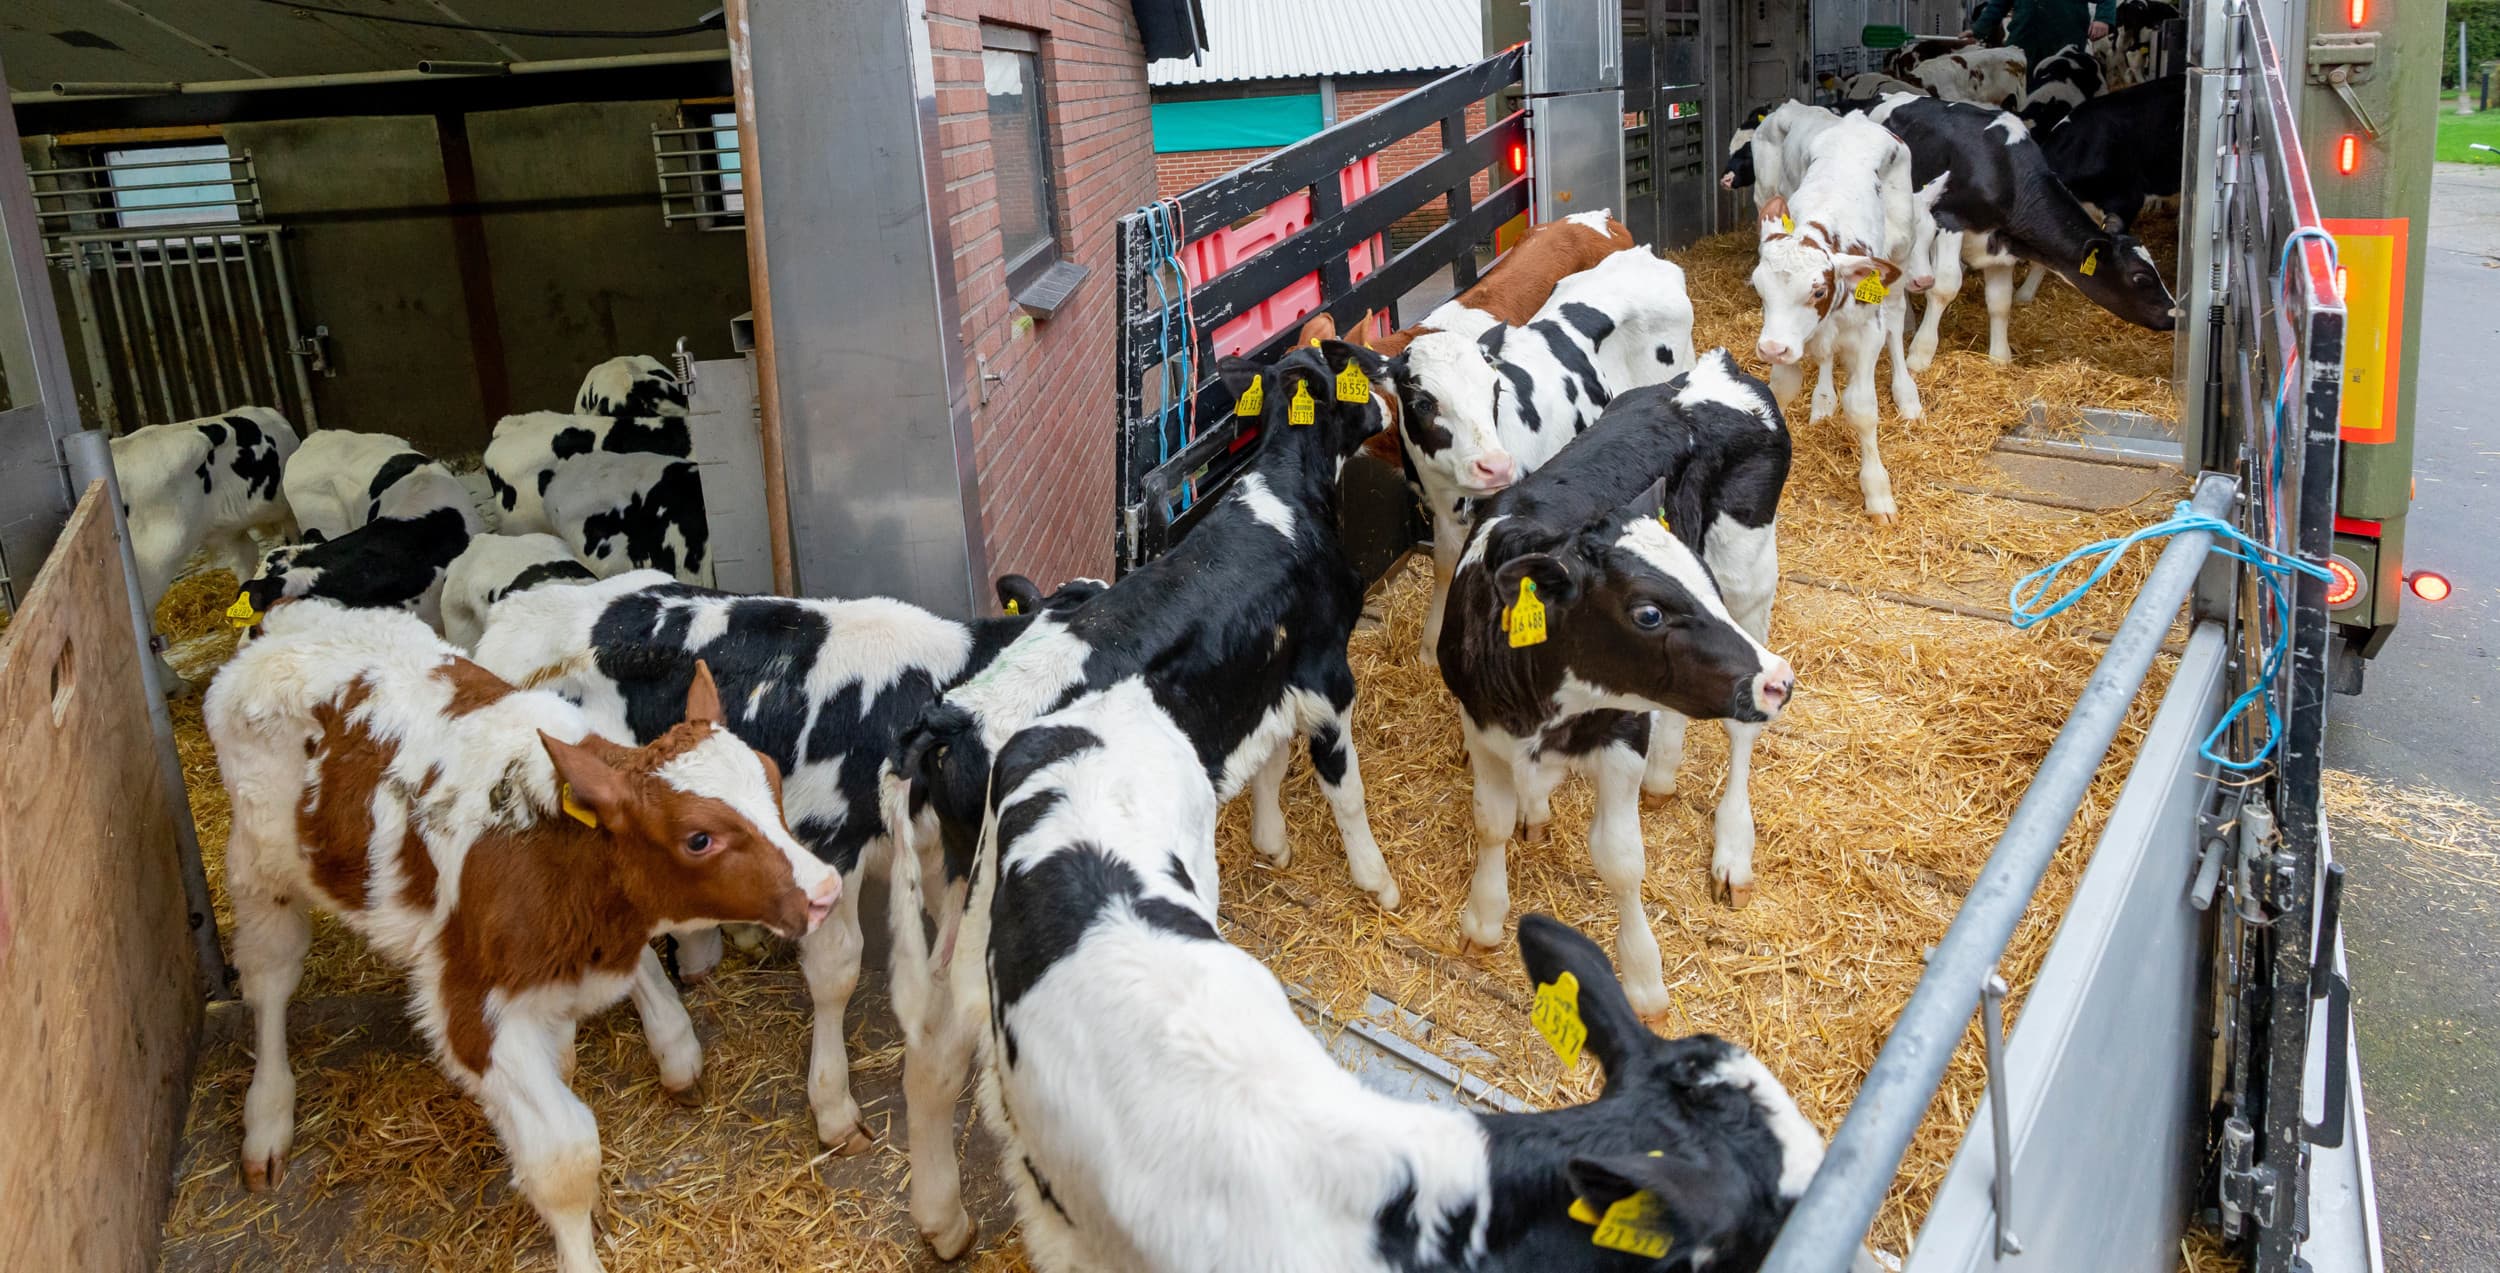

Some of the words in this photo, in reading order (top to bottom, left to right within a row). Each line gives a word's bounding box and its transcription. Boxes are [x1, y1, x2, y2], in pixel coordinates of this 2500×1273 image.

[1856, 289, 1866, 299] 01
[1867, 292, 1882, 304] 735
[1349, 383, 1367, 396] 552
[1513, 616, 1524, 634] 16
[1599, 1225, 1625, 1245] 21
